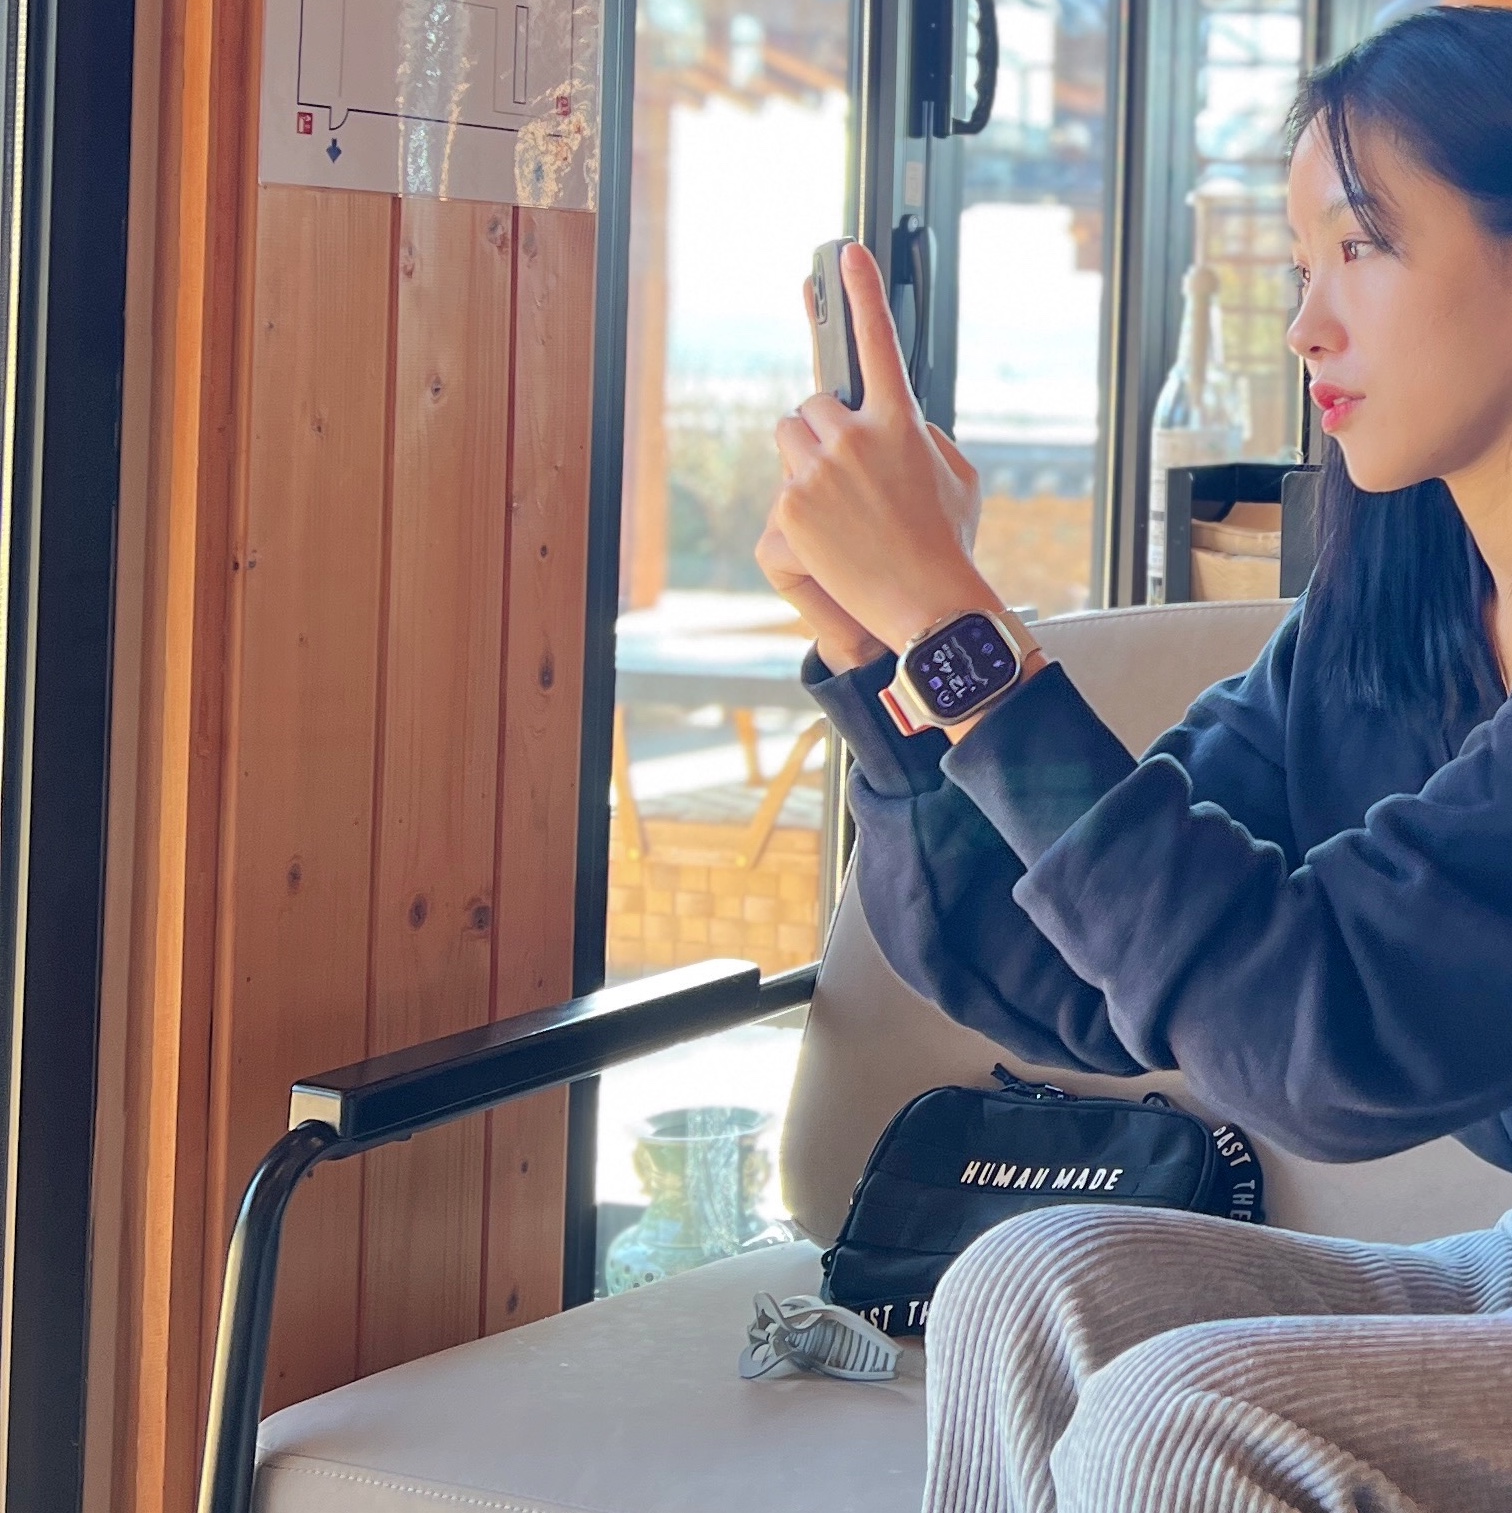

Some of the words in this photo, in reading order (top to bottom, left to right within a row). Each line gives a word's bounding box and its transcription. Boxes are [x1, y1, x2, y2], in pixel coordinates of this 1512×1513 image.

[960, 1160, 1050, 1189] HUMAN
[1052, 1167, 1123, 1190] MADE
[1230, 1179, 1255, 1220] THE
